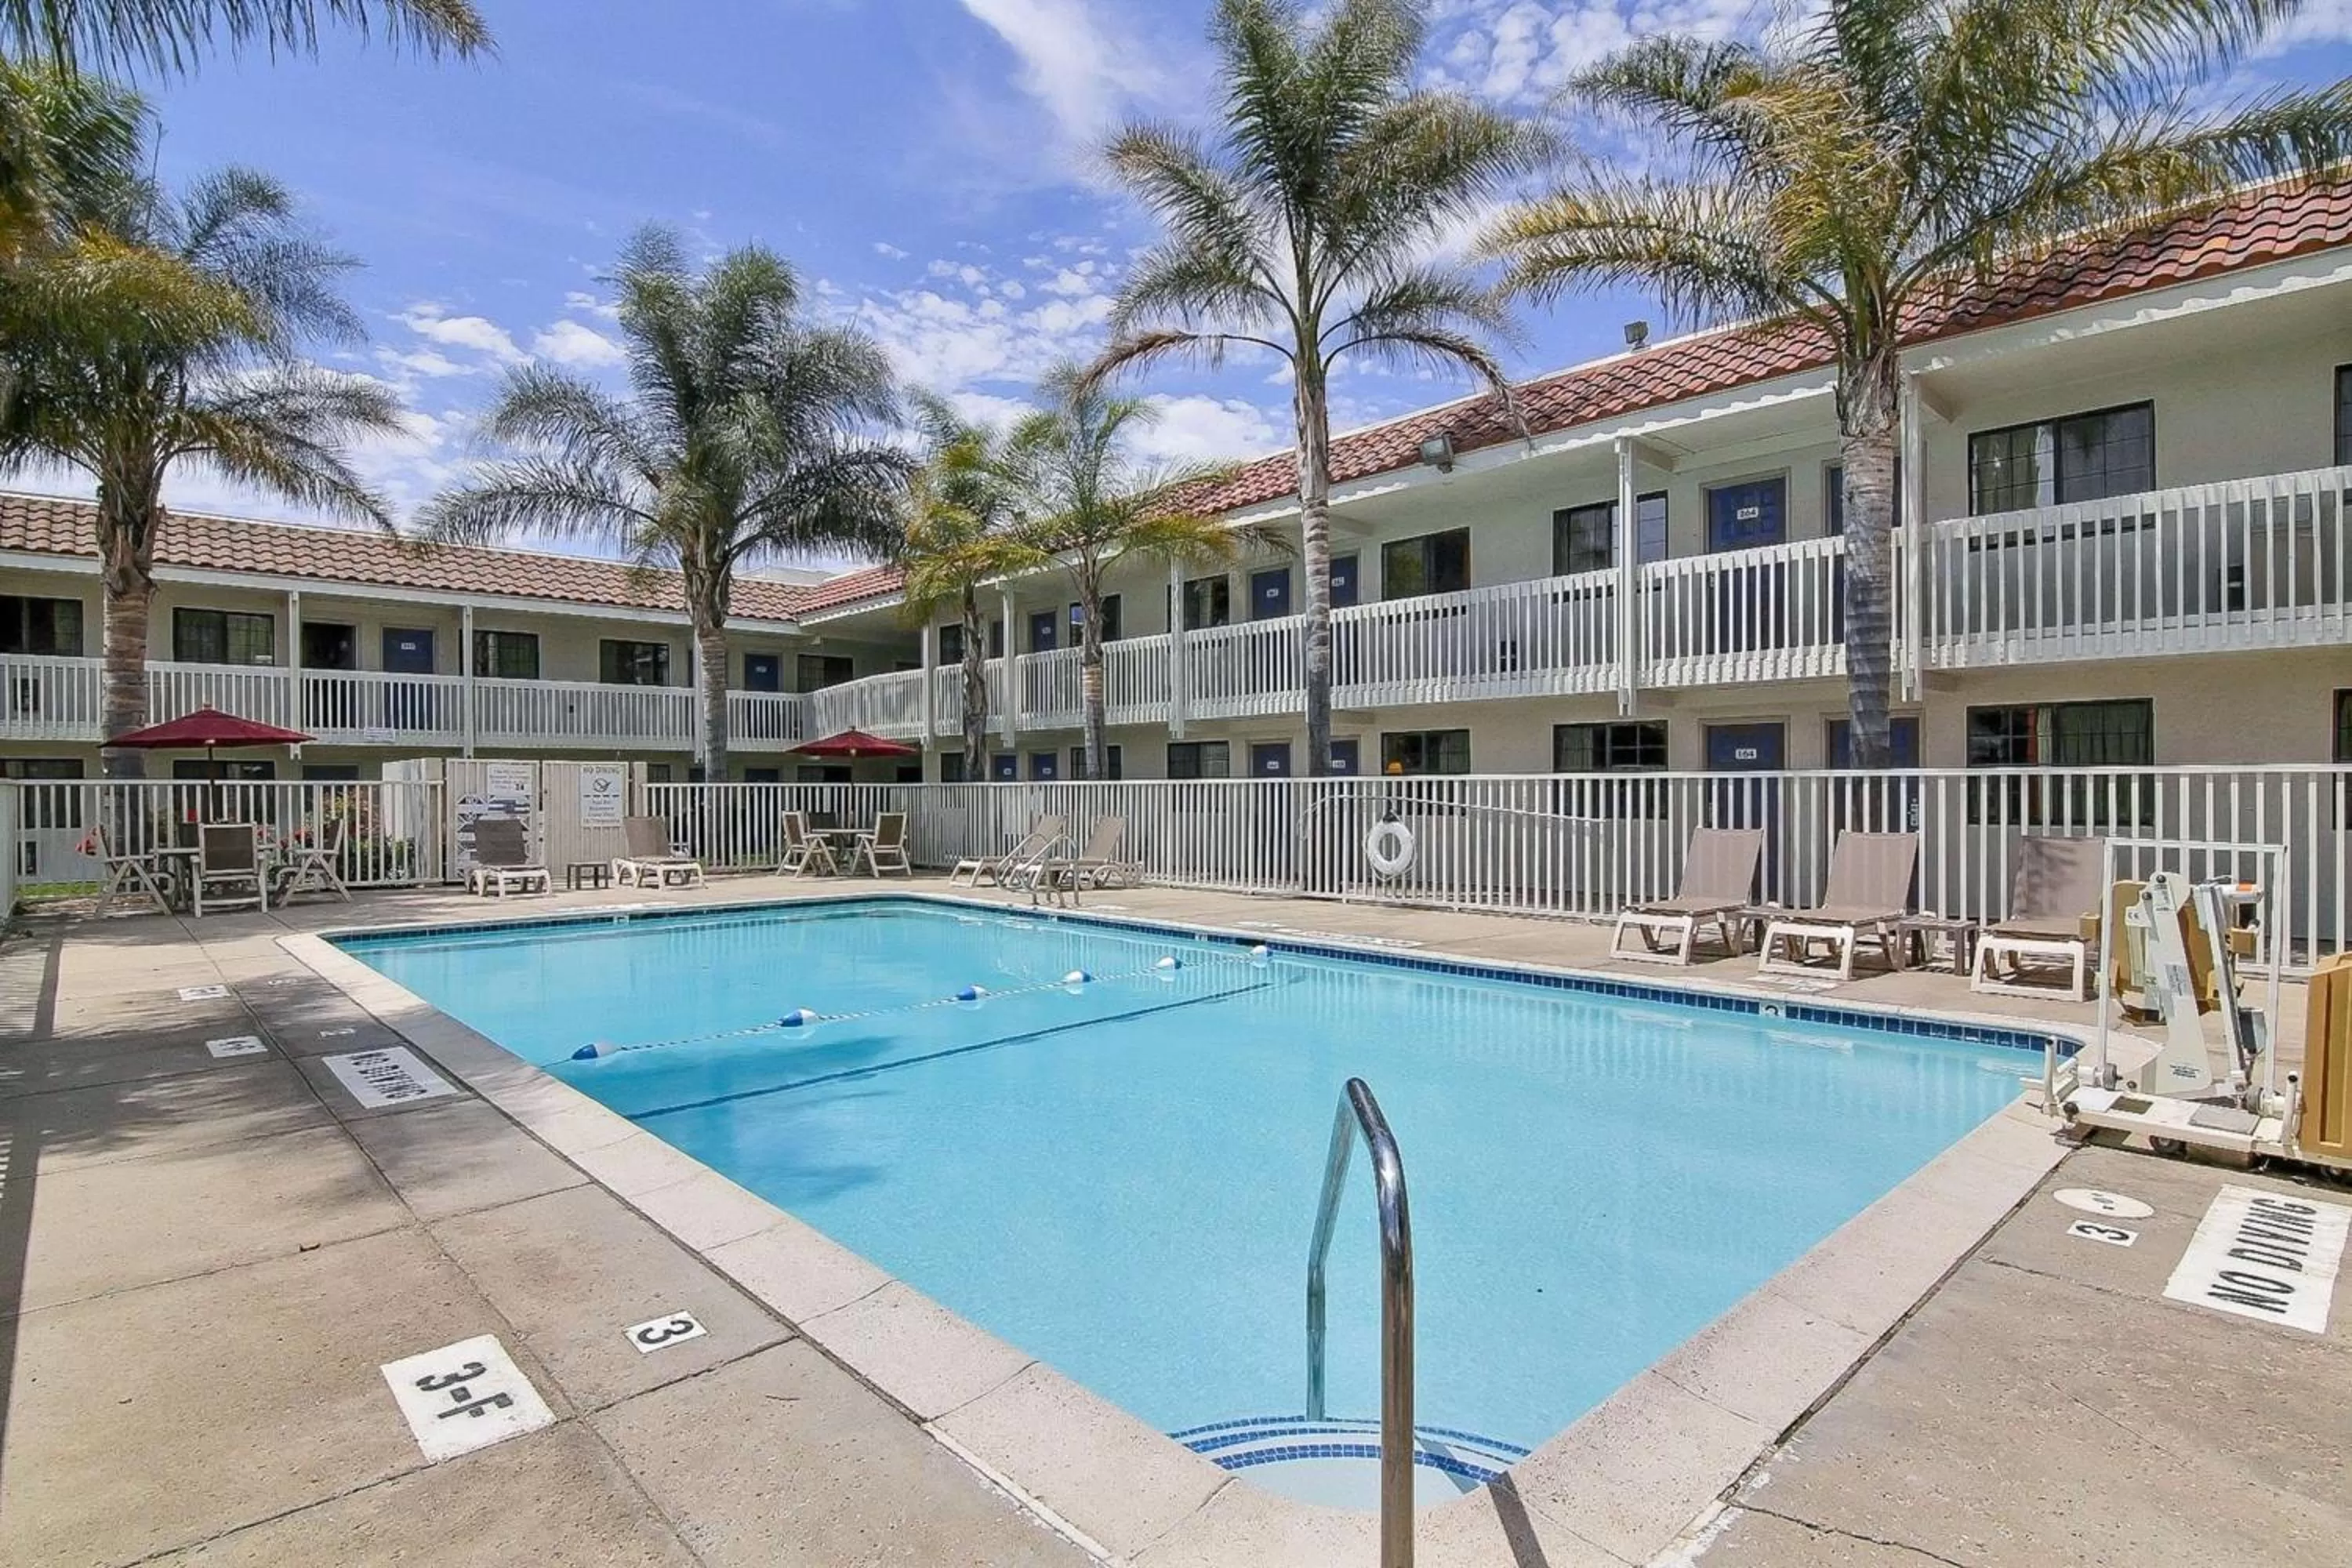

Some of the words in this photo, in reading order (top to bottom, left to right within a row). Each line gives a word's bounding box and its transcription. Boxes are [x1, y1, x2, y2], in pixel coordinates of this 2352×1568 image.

[348, 1052, 390, 1065] NO
[358, 1065, 427, 1098] DIVING
[2075, 1225, 2130, 1240] 3
[2227, 1198, 2318, 1272] DIVING
[2207, 1271, 2296, 1314] NO
[637, 1318, 695, 1345] 3
[415, 1361, 514, 1420] 3-F
